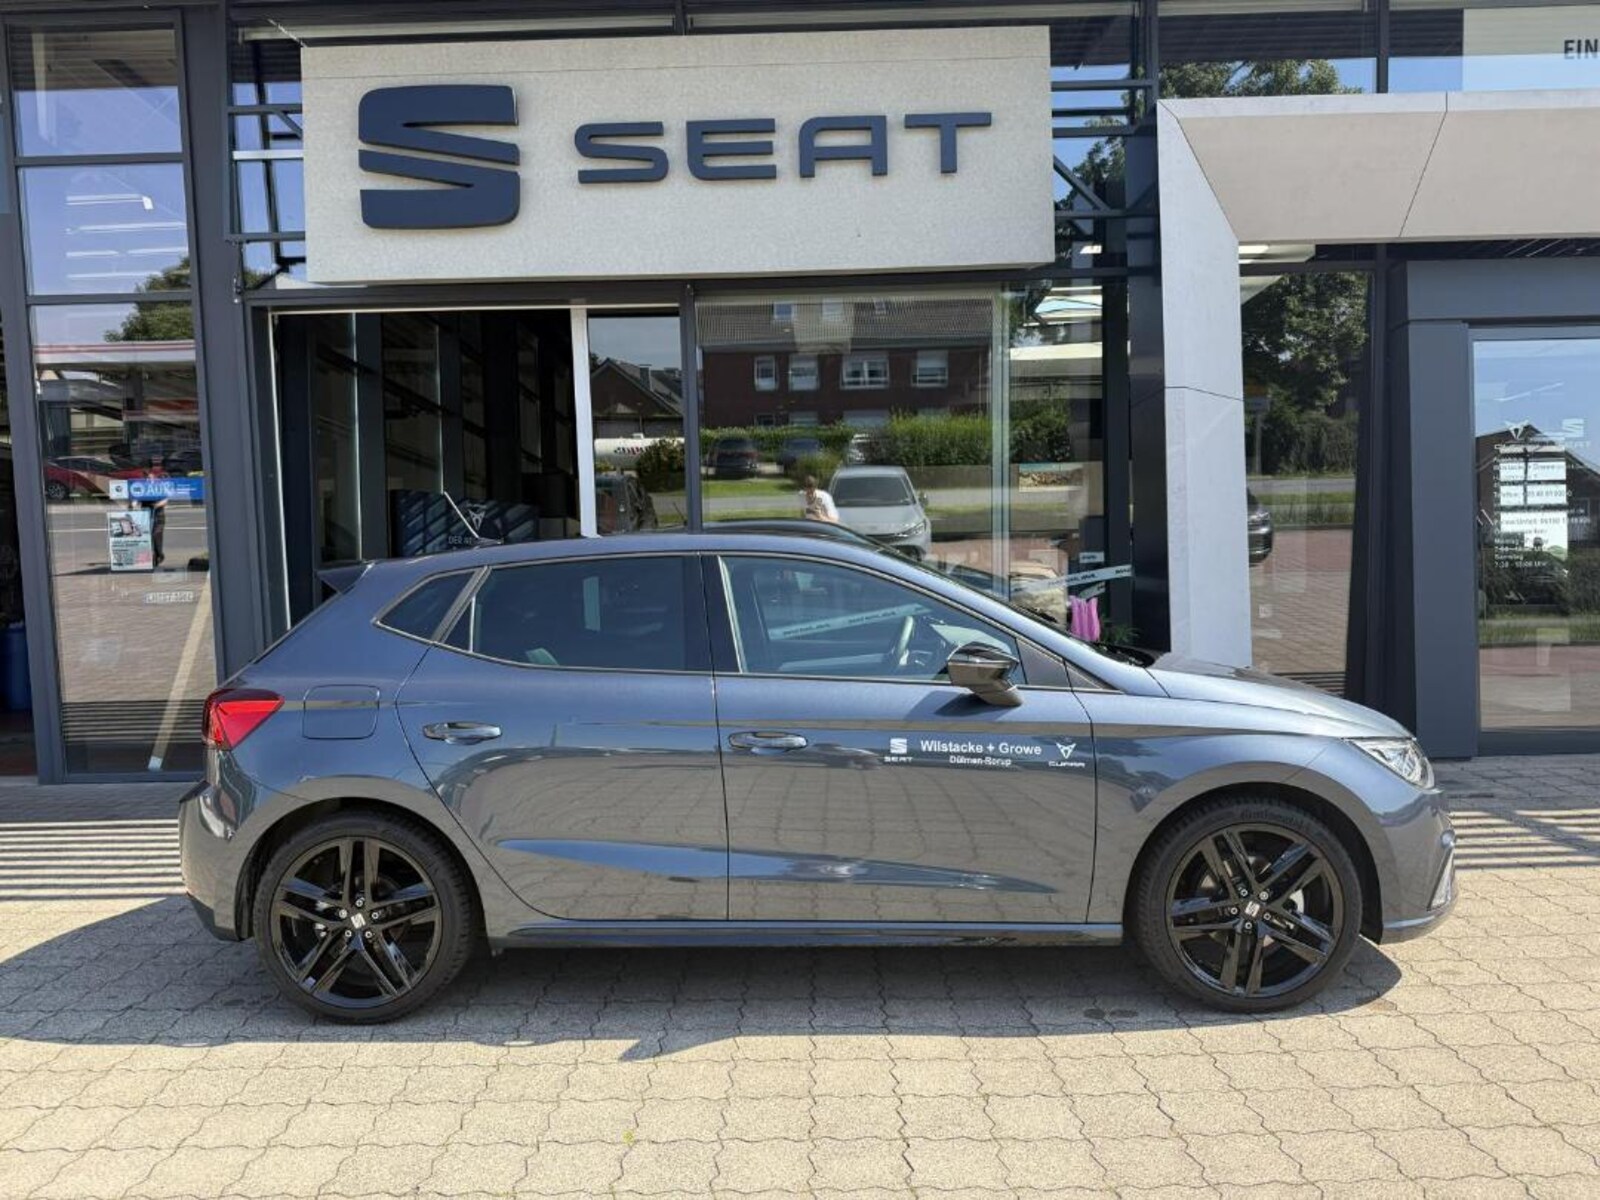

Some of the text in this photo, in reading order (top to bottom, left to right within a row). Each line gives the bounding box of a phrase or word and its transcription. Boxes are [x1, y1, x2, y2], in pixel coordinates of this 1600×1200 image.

[1564, 39, 1598, 60] EIN
[574, 111, 992, 185] SEAT
[920, 740, 983, 753] Wilstacke
[999, 742, 1042, 755] Growe
